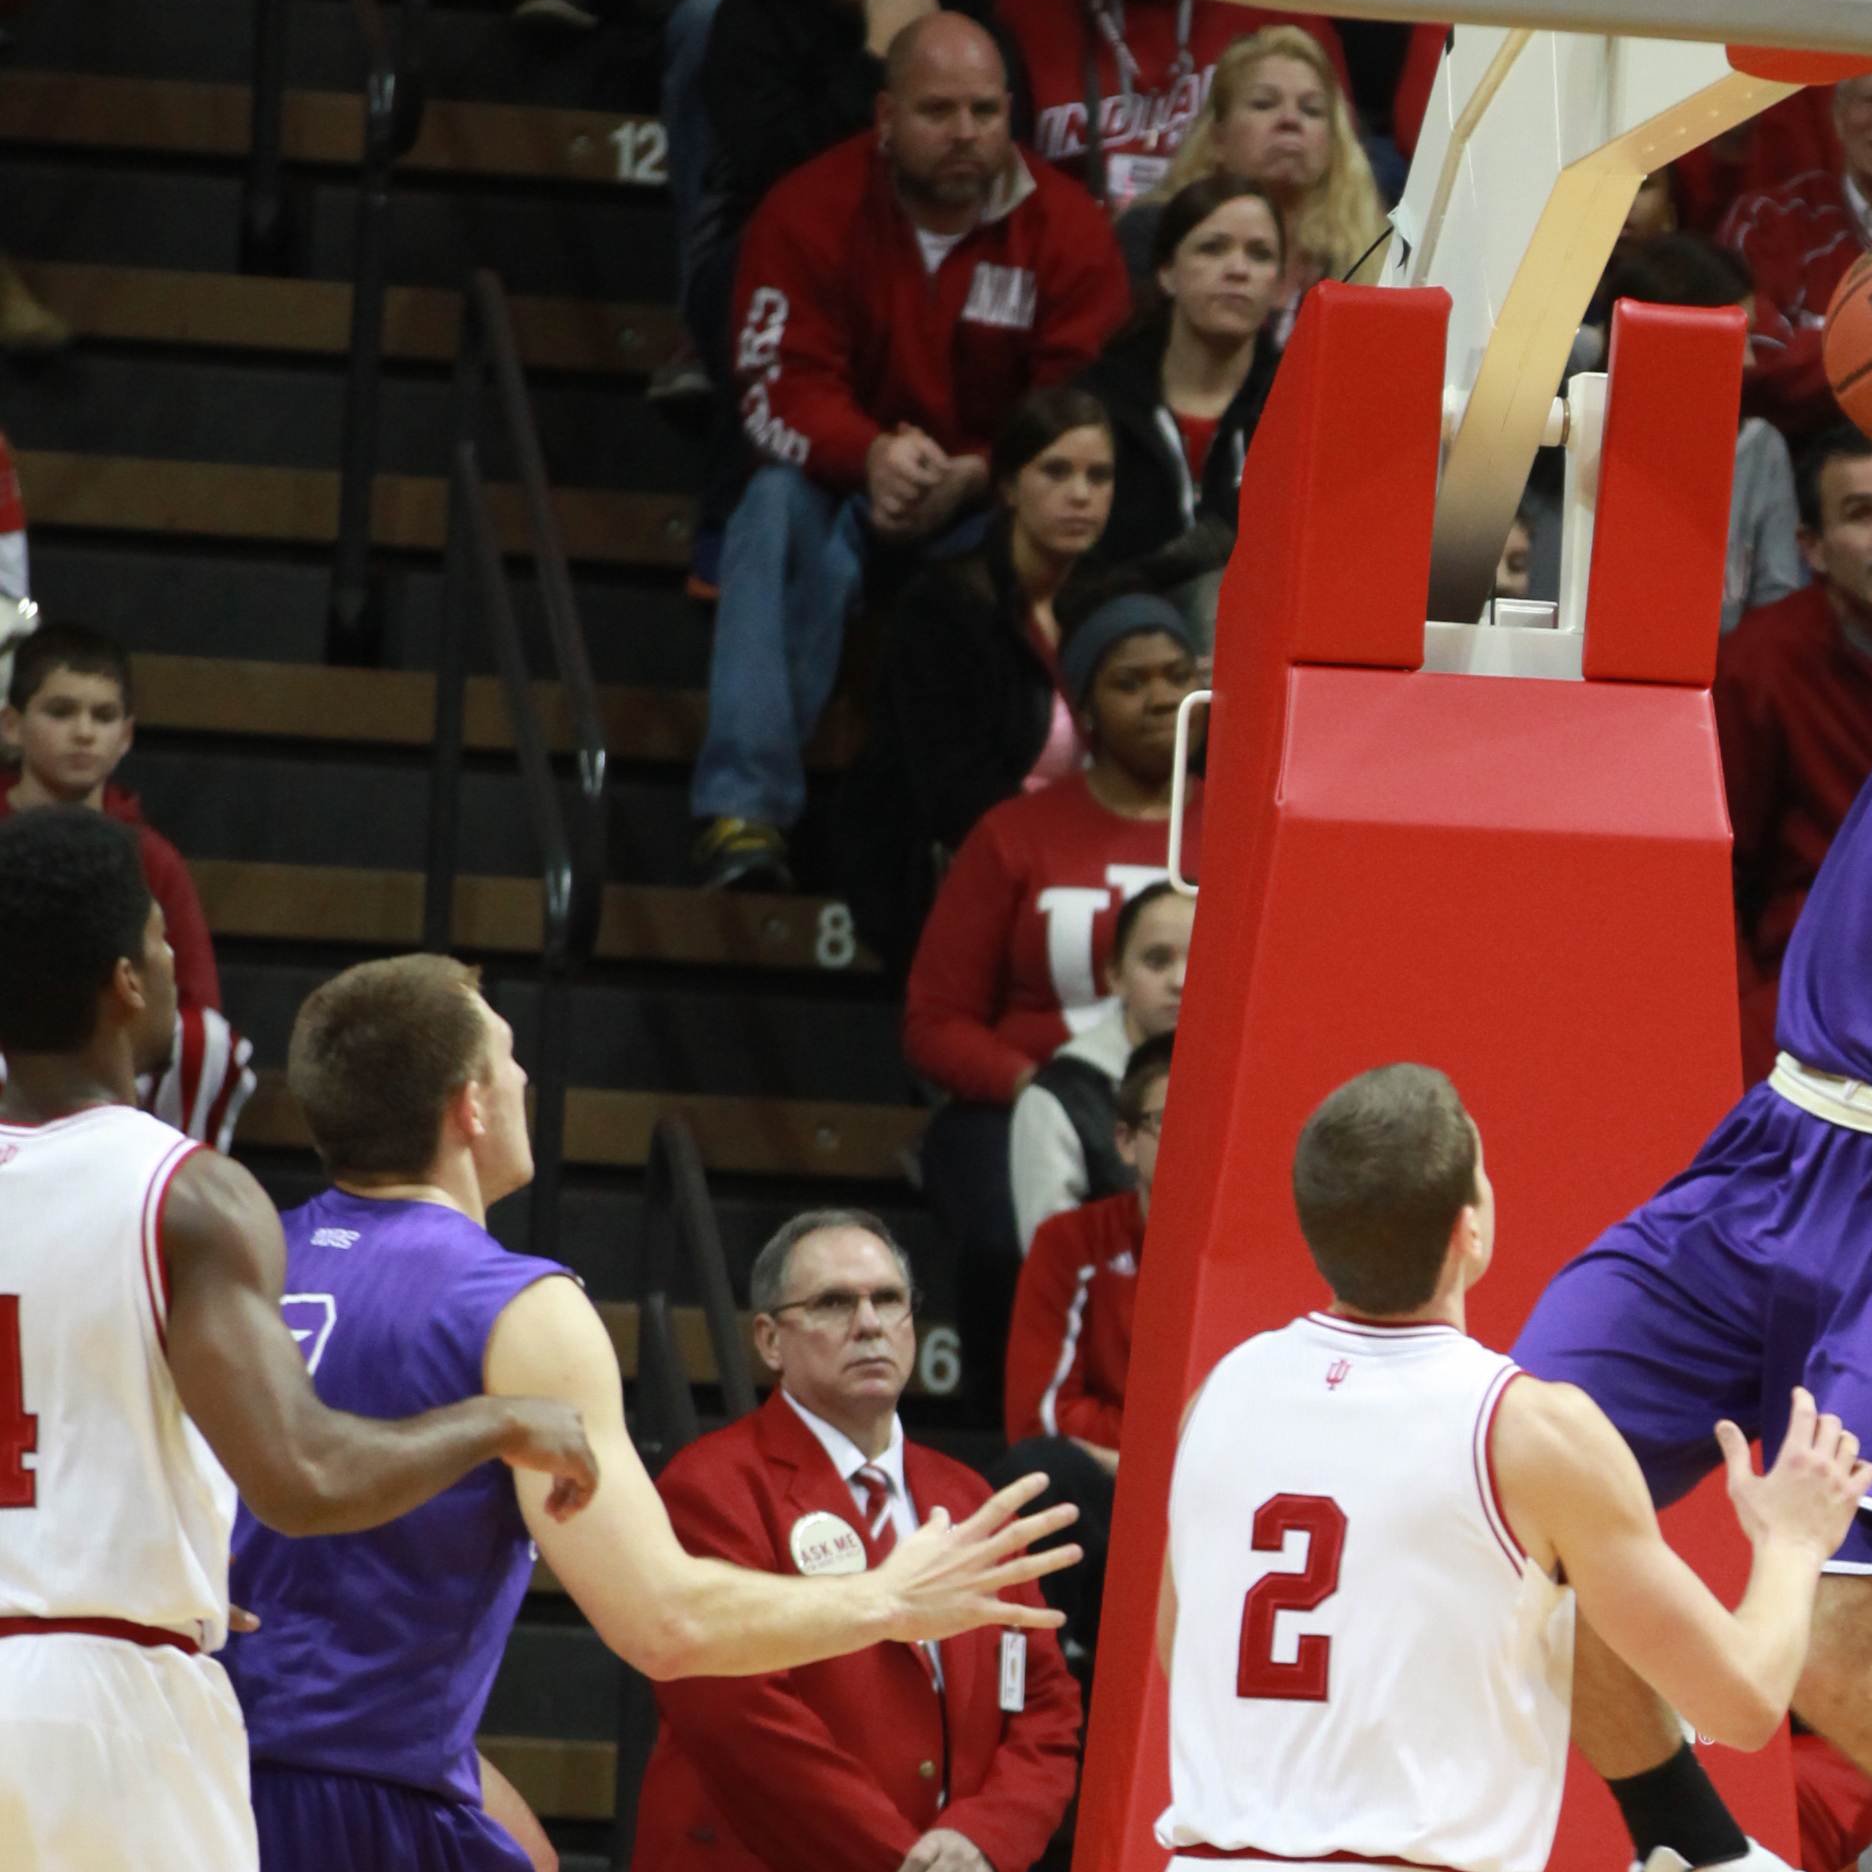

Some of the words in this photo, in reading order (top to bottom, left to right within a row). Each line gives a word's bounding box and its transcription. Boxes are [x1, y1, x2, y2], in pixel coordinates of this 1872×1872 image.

[609, 120, 669, 185] 12
[815, 902, 855, 971] 8
[919, 1326, 962, 1396] 6
[1236, 1491, 1349, 1703] 2
